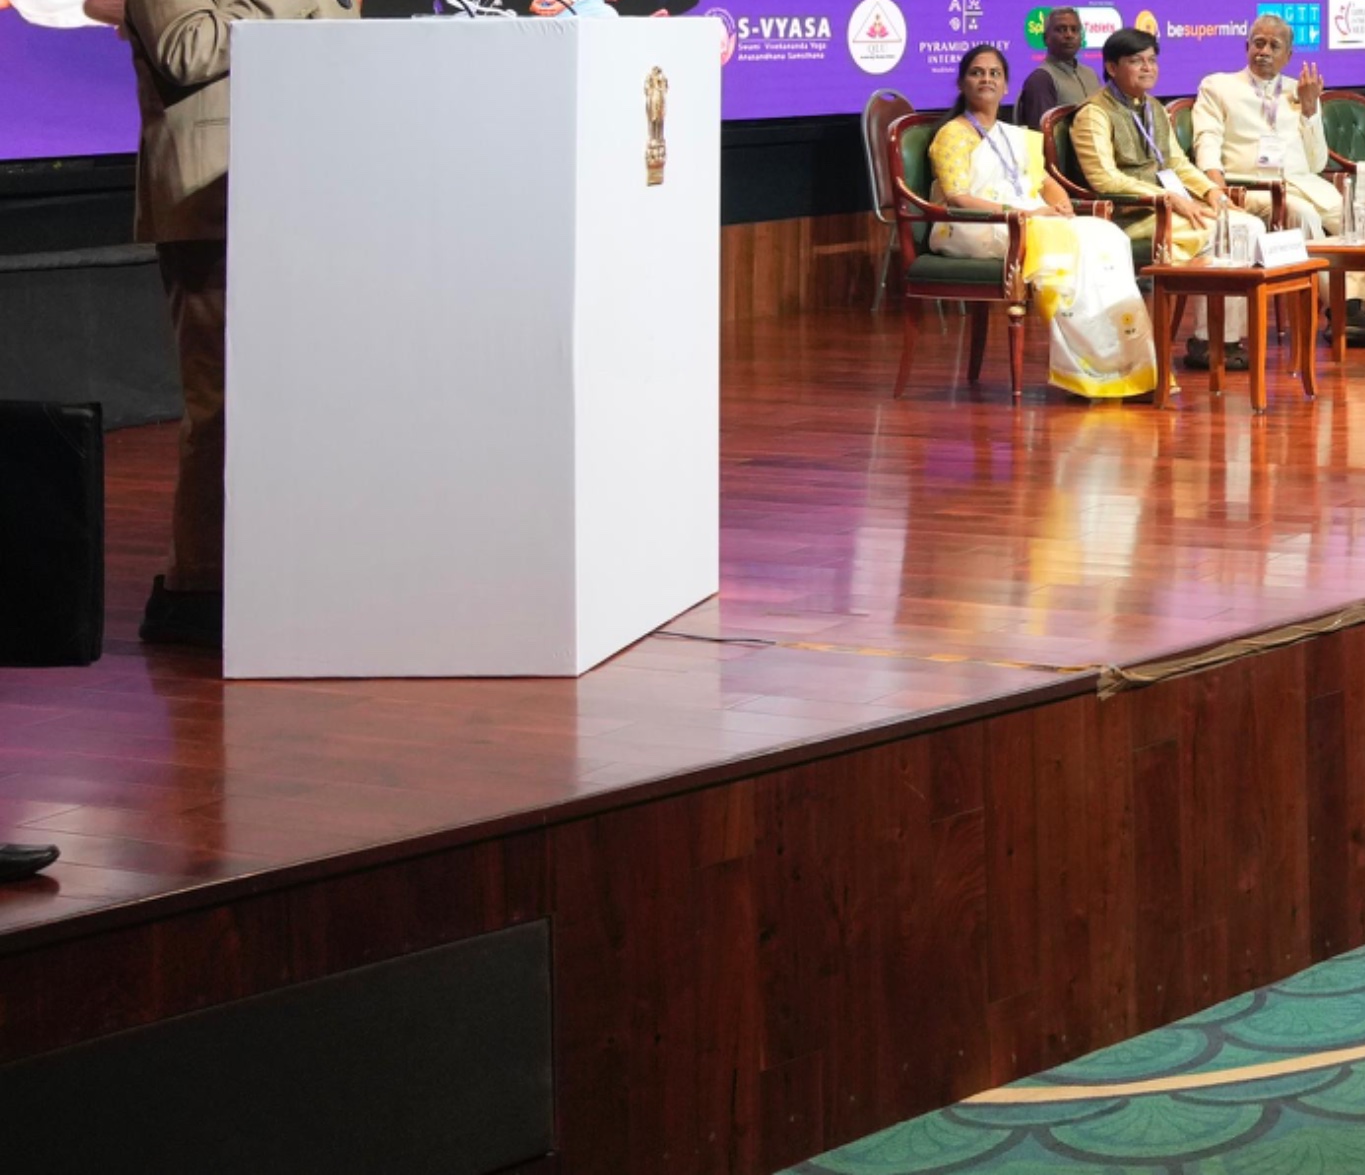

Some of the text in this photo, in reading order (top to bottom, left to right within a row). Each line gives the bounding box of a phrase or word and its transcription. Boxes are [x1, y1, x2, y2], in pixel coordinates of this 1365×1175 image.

[737, 17, 831, 39] S-VYASA
[1167, 20, 1247, 41] besupermind
[919, 41, 969, 52] PYRAMID
